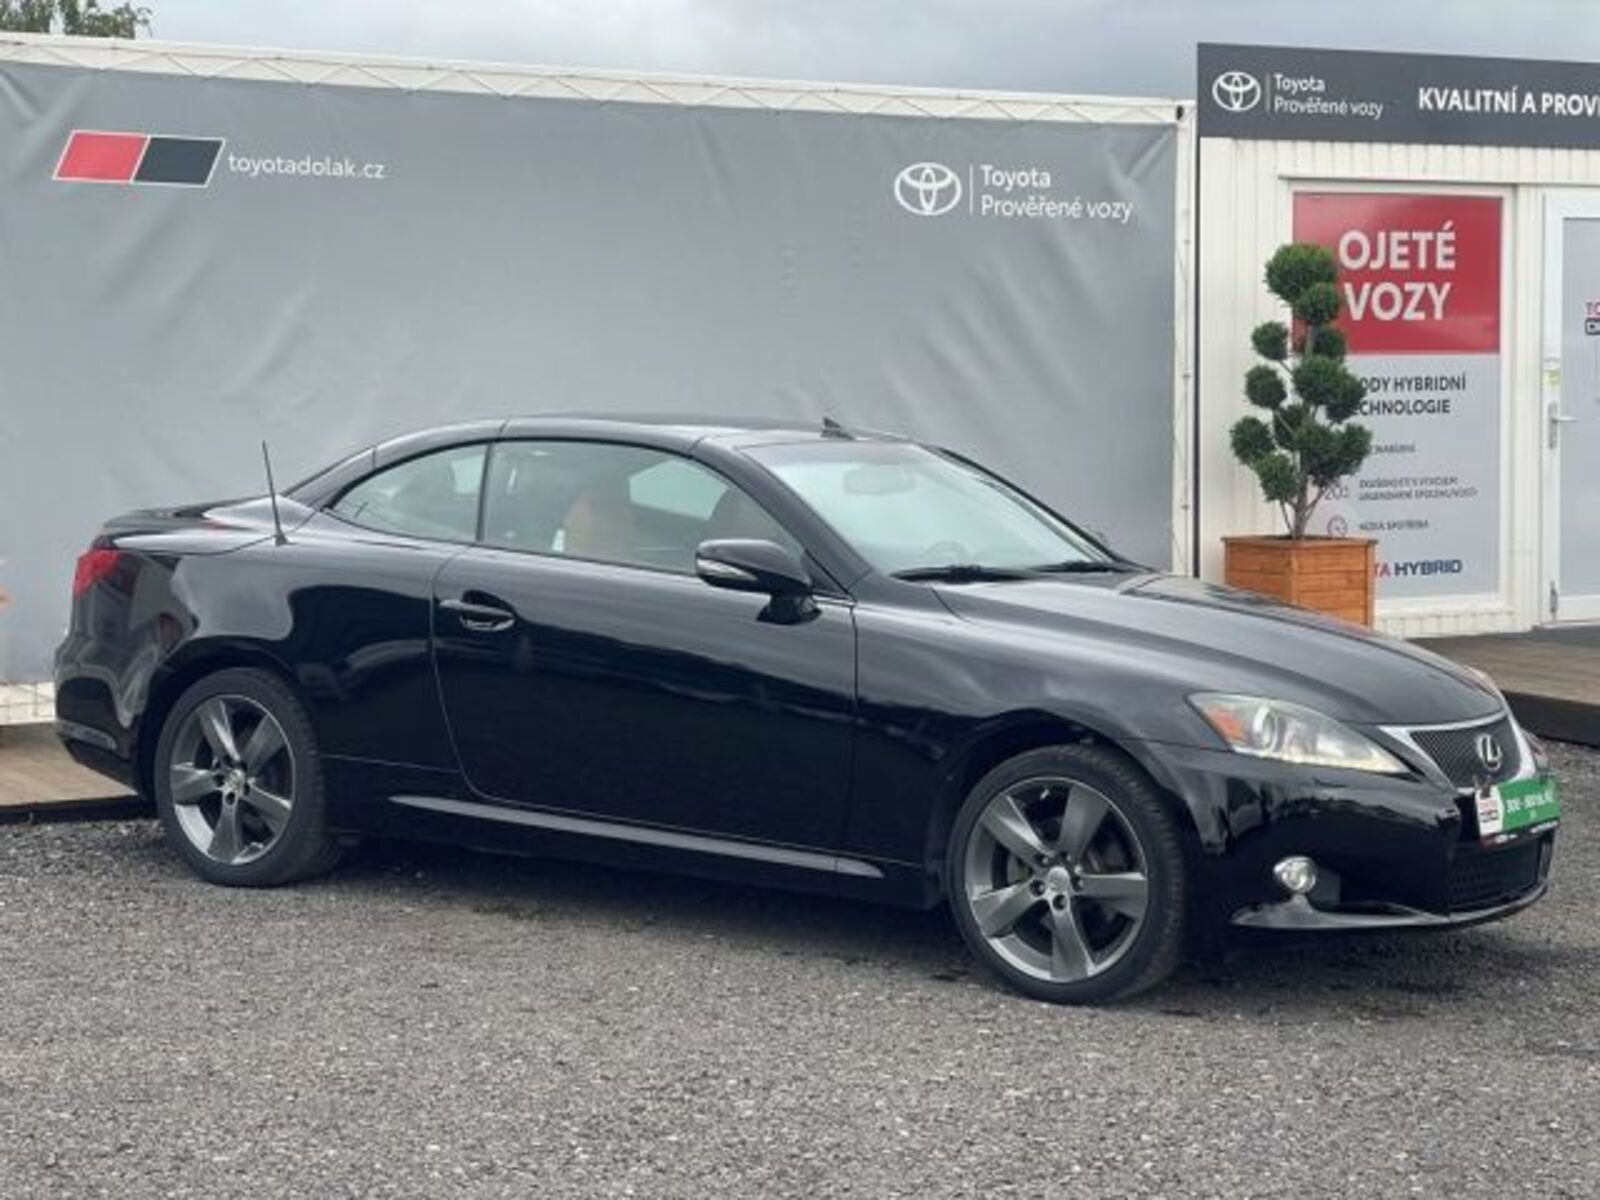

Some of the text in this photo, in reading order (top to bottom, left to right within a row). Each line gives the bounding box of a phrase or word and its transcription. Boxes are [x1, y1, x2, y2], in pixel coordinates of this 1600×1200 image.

[1274, 72, 1326, 96] Toyota
[1274, 95, 1384, 121] Prověřené vozy
[1418, 84, 1600, 117] KVALITNÍ A PROV
[228, 152, 386, 179] toyotadolak.cz
[980, 165, 1051, 191] Toyota
[981, 195, 1133, 223] Prověřené vozy
[1339, 220, 1456, 270] OJETÉ
[1344, 281, 1451, 321] VOZY
[1359, 372, 1467, 393] ODY HYBRIDNÍ
[1358, 398, 1451, 417] CHNOLOGIE
[1394, 558, 1463, 577] HYBRID
